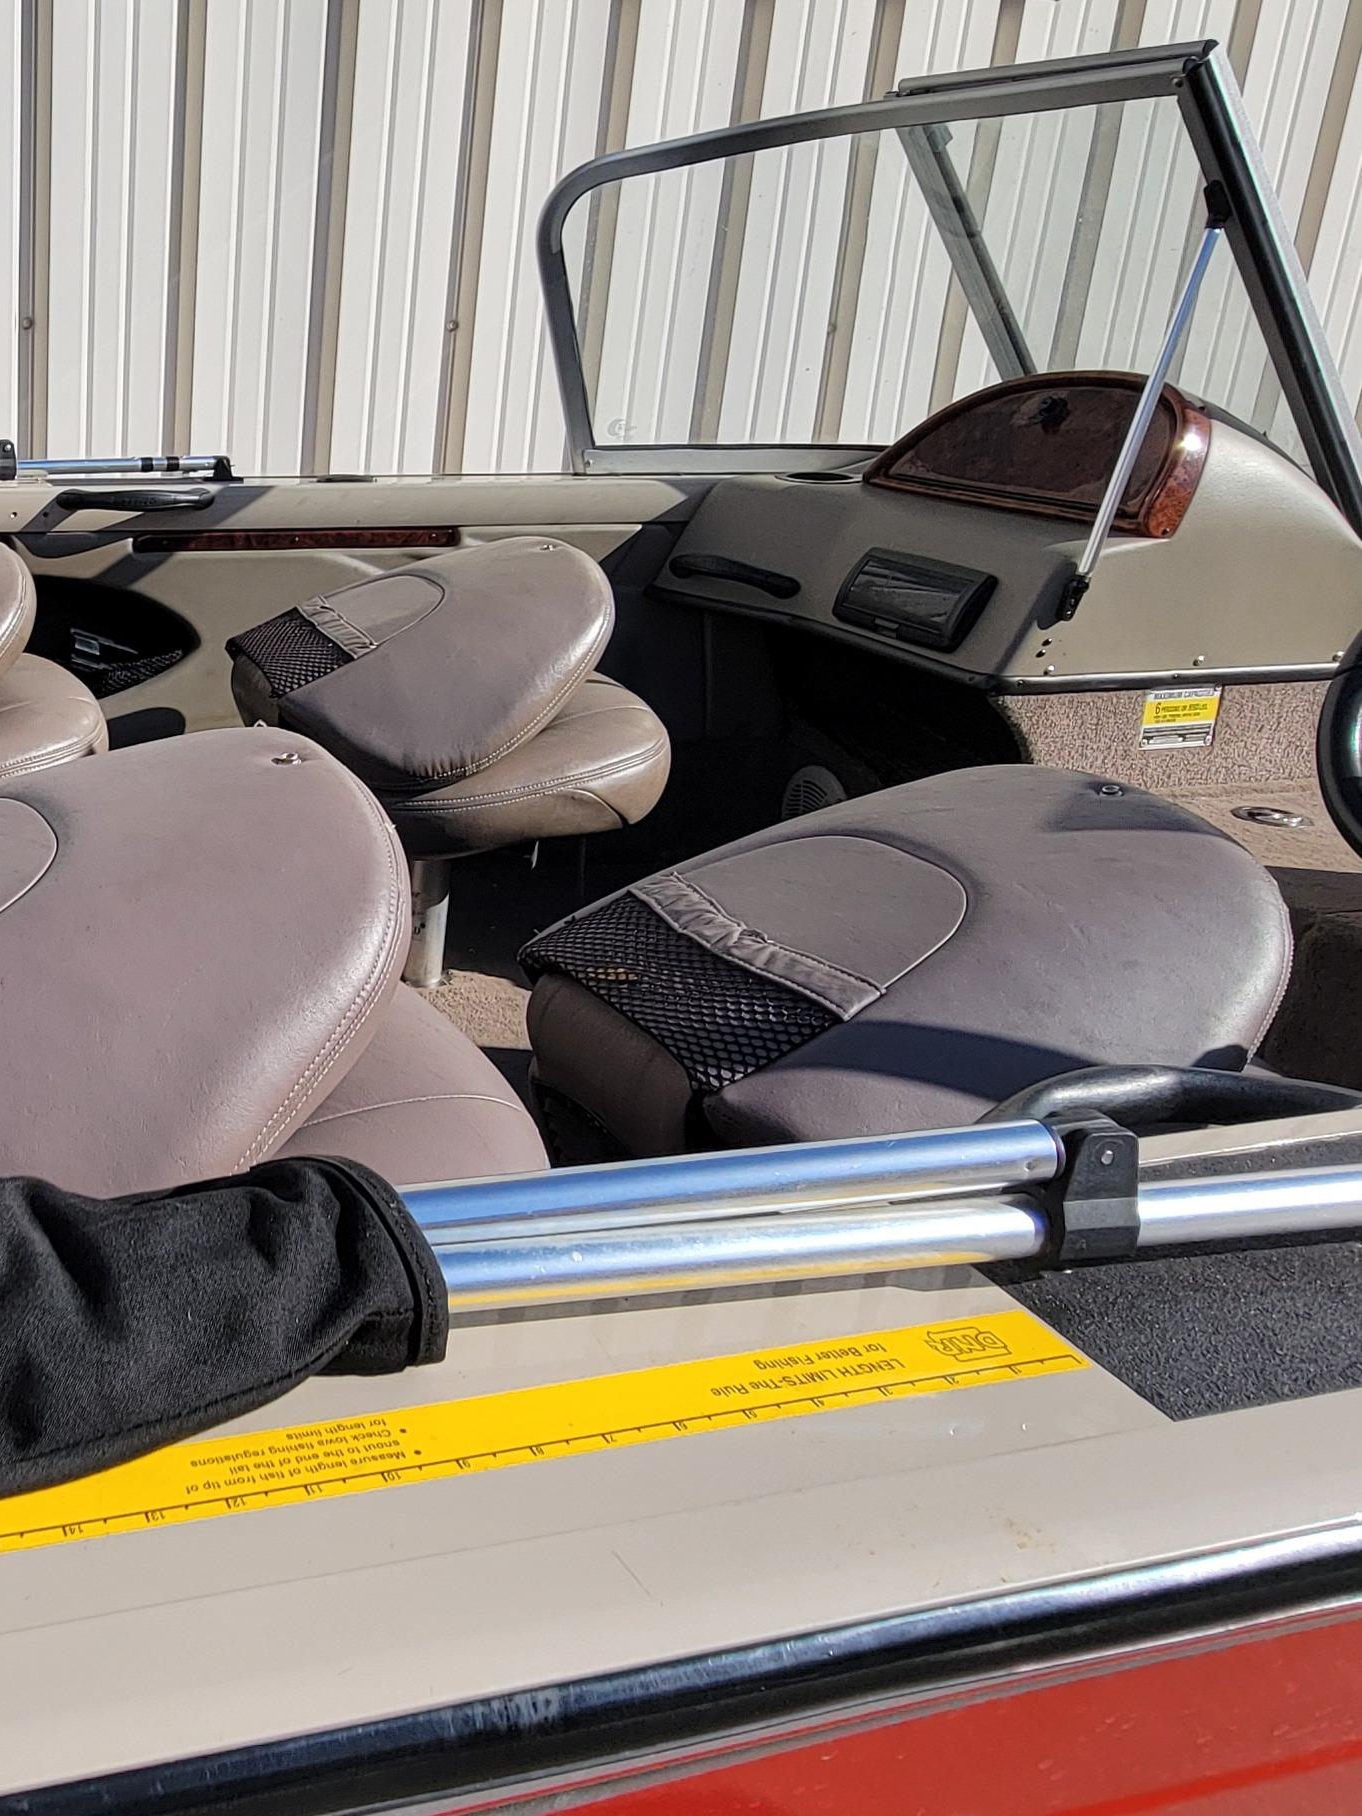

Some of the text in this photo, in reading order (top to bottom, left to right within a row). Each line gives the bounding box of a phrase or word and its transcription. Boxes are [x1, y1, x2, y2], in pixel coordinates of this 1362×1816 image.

[923, 1330, 1007, 1356] DNR
[752, 1342, 888, 1371] for Better Fishing
[709, 1358, 906, 1398] LENGTH LIMITS-The Rule
[285, 1418, 387, 1441] for length limits
[189, 1429, 392, 1468] Check Iowa fishing regulations
[228, 1439, 401, 1476] snout to the end of the tail
[185, 1450, 407, 1495] Measure length of fish from tip of
[386, 1469, 402, 1482] 10
[309, 1483, 323, 1495] 11
[230, 1496, 246, 1508] 12
[149, 1509, 166, 1522] 13
[68, 1523, 84, 1536] 14
